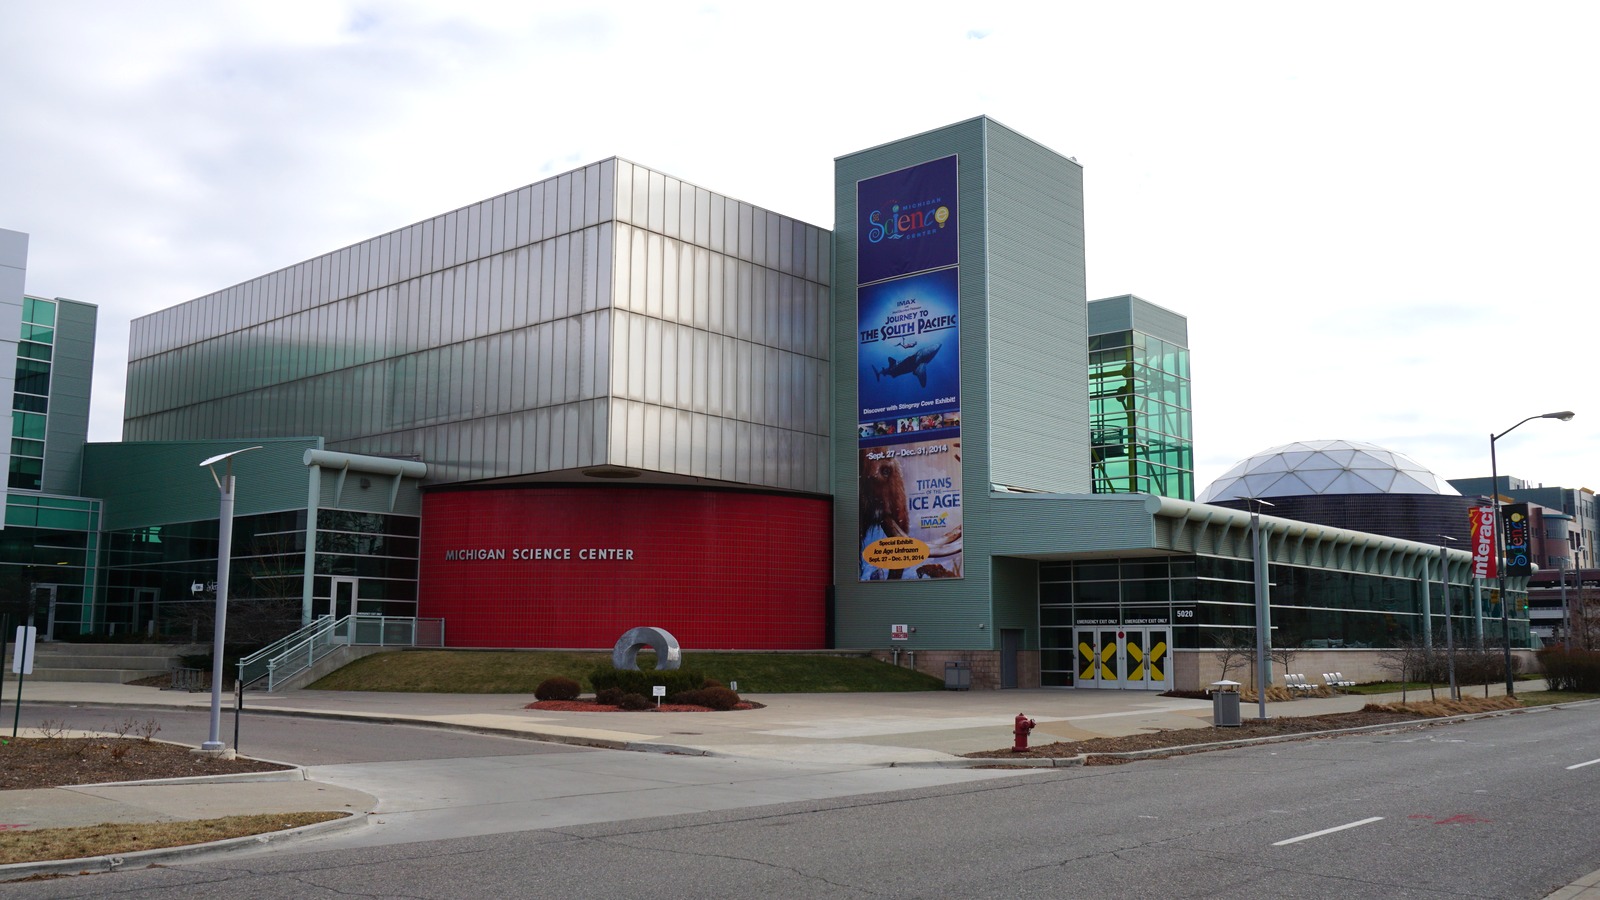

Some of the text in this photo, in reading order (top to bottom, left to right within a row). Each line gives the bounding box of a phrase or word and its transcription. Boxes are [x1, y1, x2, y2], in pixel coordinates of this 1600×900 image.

[902, 198, 941, 210] MICHIGAN
[868, 205, 950, 243] Science
[906, 229, 936, 240] CENTER
[885, 312, 918, 325] JOURNEY
[920, 310, 928, 318] TO
[860, 314, 956, 341] THE SOUTH PACIFIC
[898, 402, 920, 410] Stingray
[900, 448, 916, 456] Dec.
[917, 446, 928, 456] 31,
[929, 444, 948, 453] 2014
[916, 478, 952, 490] TITANS
[909, 494, 960, 510] ICE AGE
[921, 518, 946, 526] IMAX
[1473, 506, 1494, 578] interact
[446, 548, 634, 560] MICHIGAN SCIENCE CENTER
